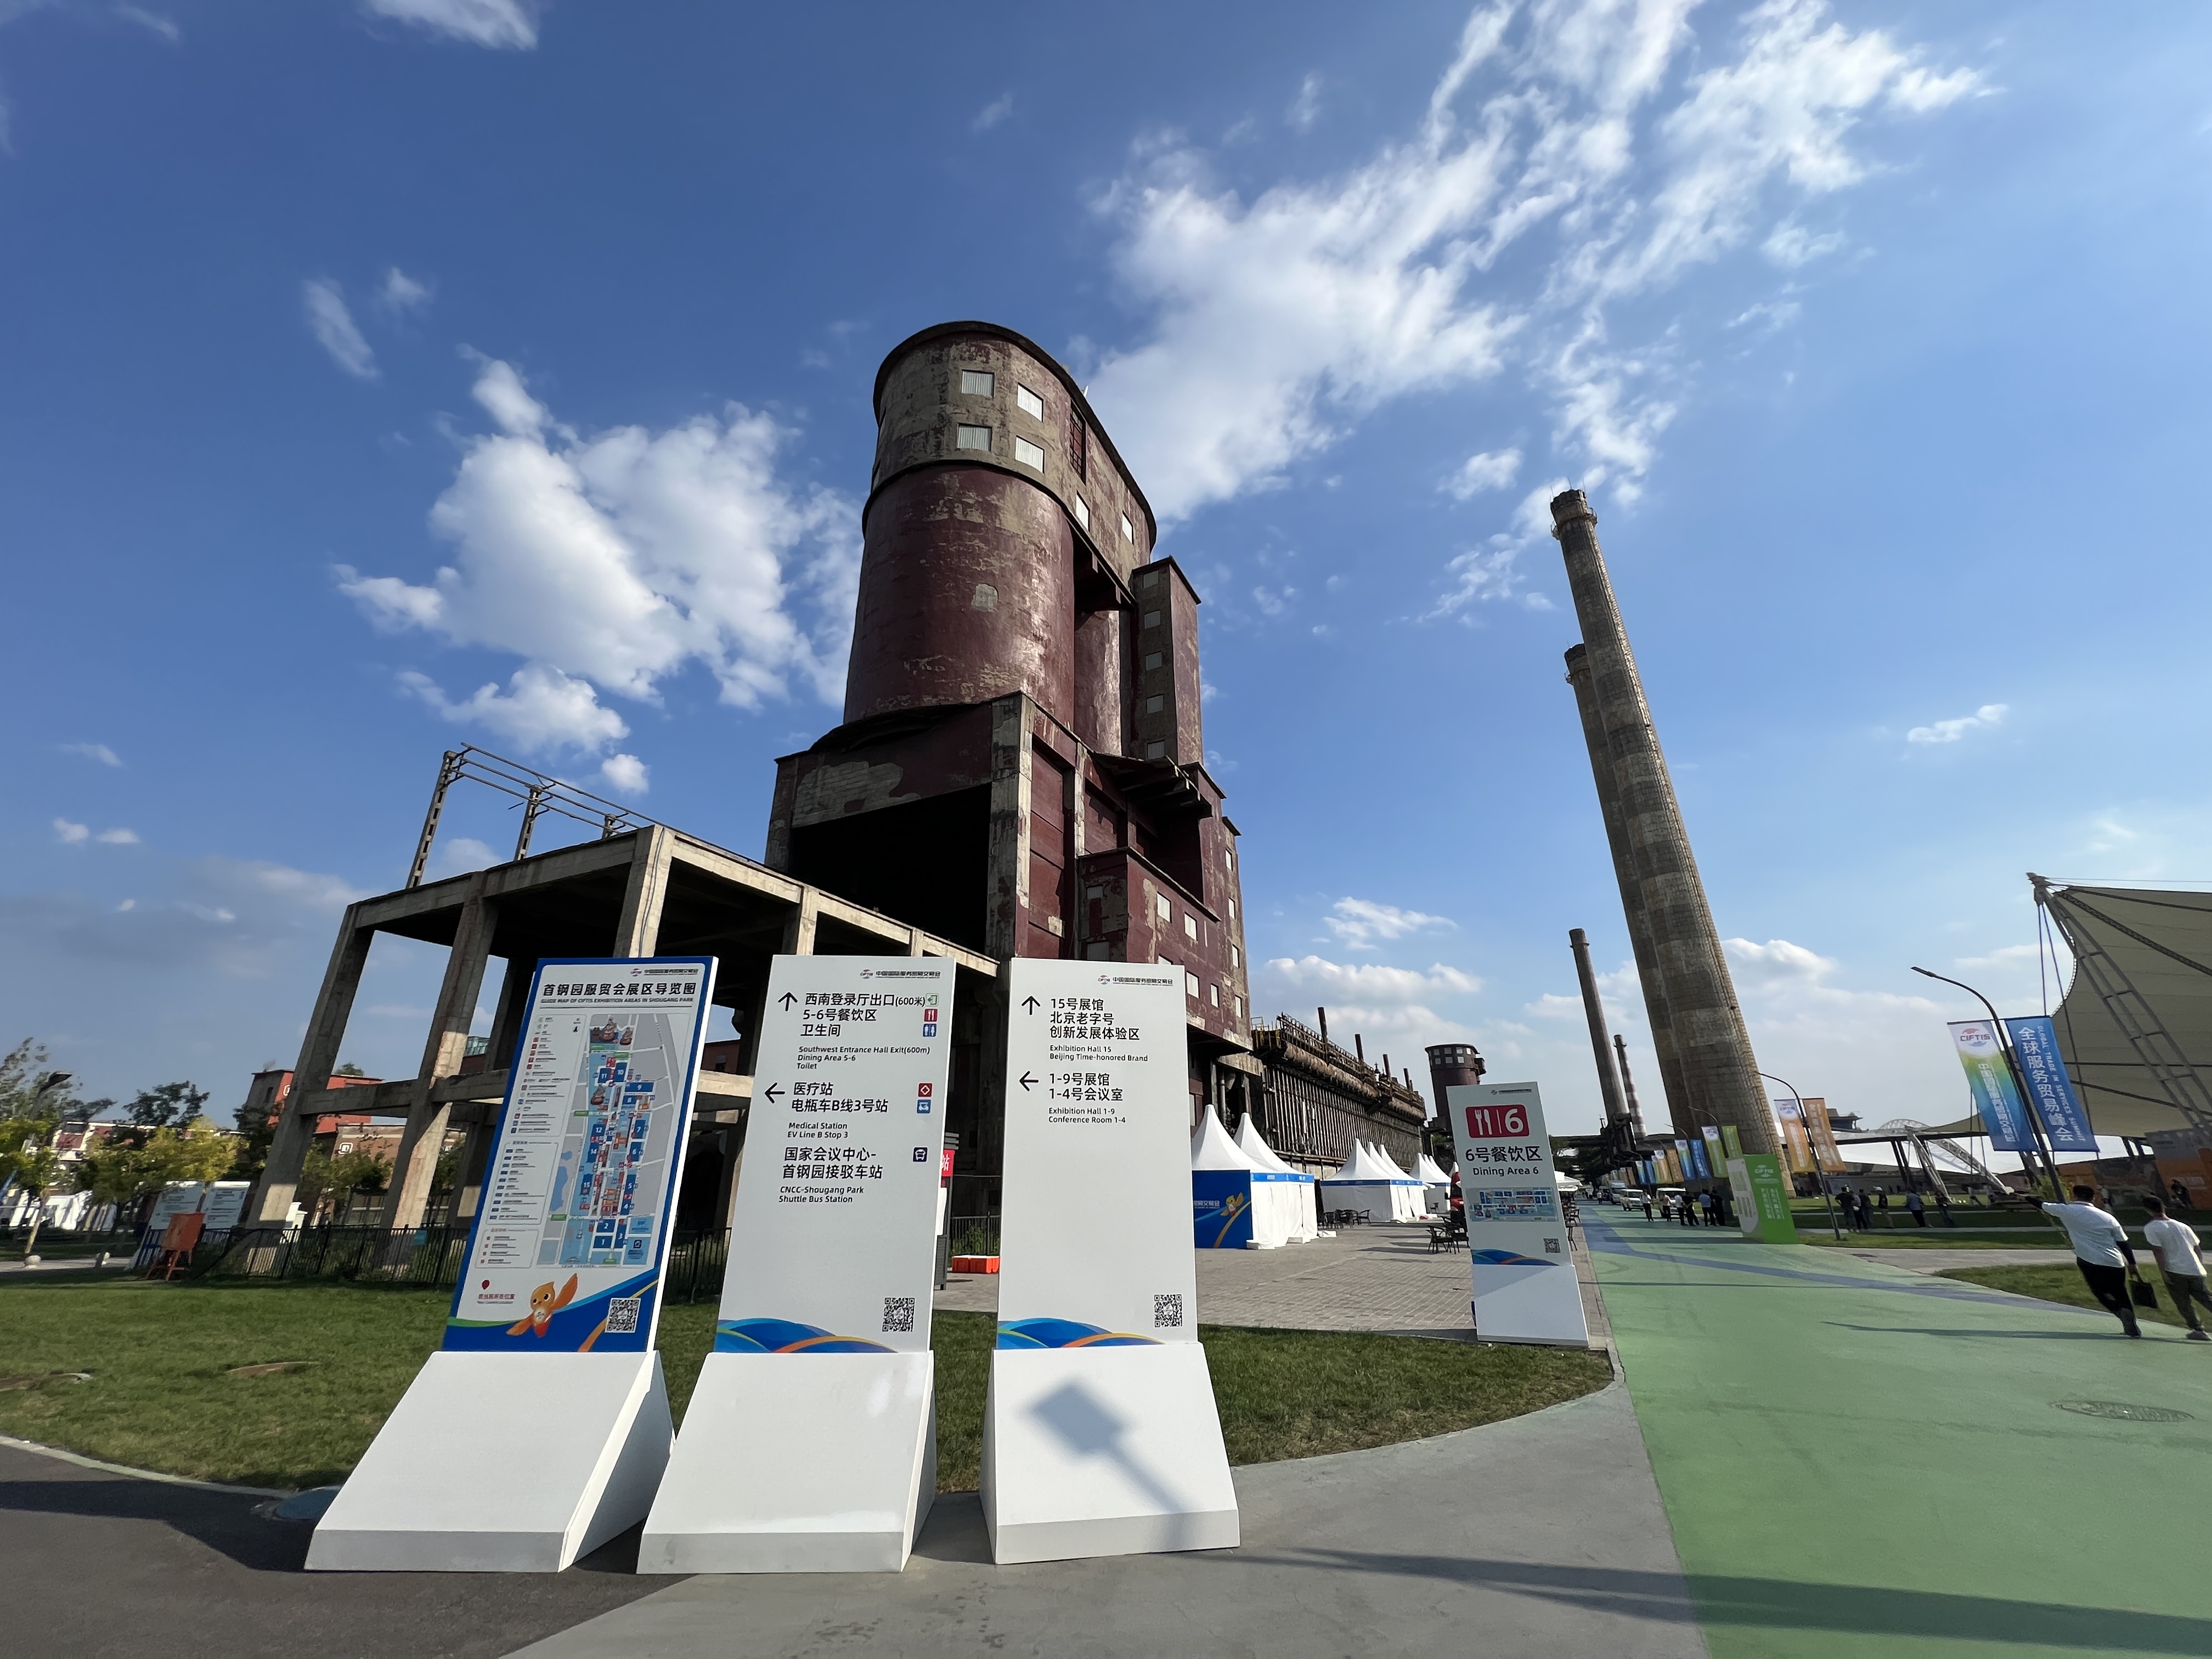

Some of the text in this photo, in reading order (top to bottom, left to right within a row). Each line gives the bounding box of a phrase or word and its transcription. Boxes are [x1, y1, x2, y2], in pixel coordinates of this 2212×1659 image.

[543, 983, 696, 996] 首钢园服贸会展区导览图
[805, 993, 926, 1007] 西南登录厅出口(600米)
[1051, 998, 1104, 1011] 15号展馆
[803, 1009, 877, 1022] 5-6号餐饮区
[1050, 1011, 1114, 1025] 北京老字号
[800, 1024, 840, 1037] 卫生间
[1049, 1025, 1140, 1040] 创新发展体验区
[890, 1046, 930, 1054] Exit(600m)
[1049, 1073, 1110, 1086] 1-9号展馆
[2018, 1026, 2074, 1142] 全球服务贸易峰会
[2037, 1025, 2049, 1048] GLOBAL
[2045, 1052, 2056, 1071] TRADE
[2055, 1085, 2073, 1114] SERVICES
[2068, 1117, 2085, 1141] SUMMIT
[793, 1082, 833, 1096] 医疗站
[1049, 1088, 1123, 1101] 1-4号会议室
[791, 1099, 888, 1113] 电瓶车B线3号站
[1505, 1108, 1523, 1133] 6
[824, 1131, 842, 1139] Stop
[784, 1147, 876, 1161] 国家会议中心-
[1465, 1146, 1543, 1163] 6号餐饮区
[782, 1164, 883, 1180] 首钢园接驳车站
[1472, 1167, 1504, 1177] Dining
[1507, 1166, 1530, 1175] Area
[780, 1186, 844, 1194] CNCC-Shougang
